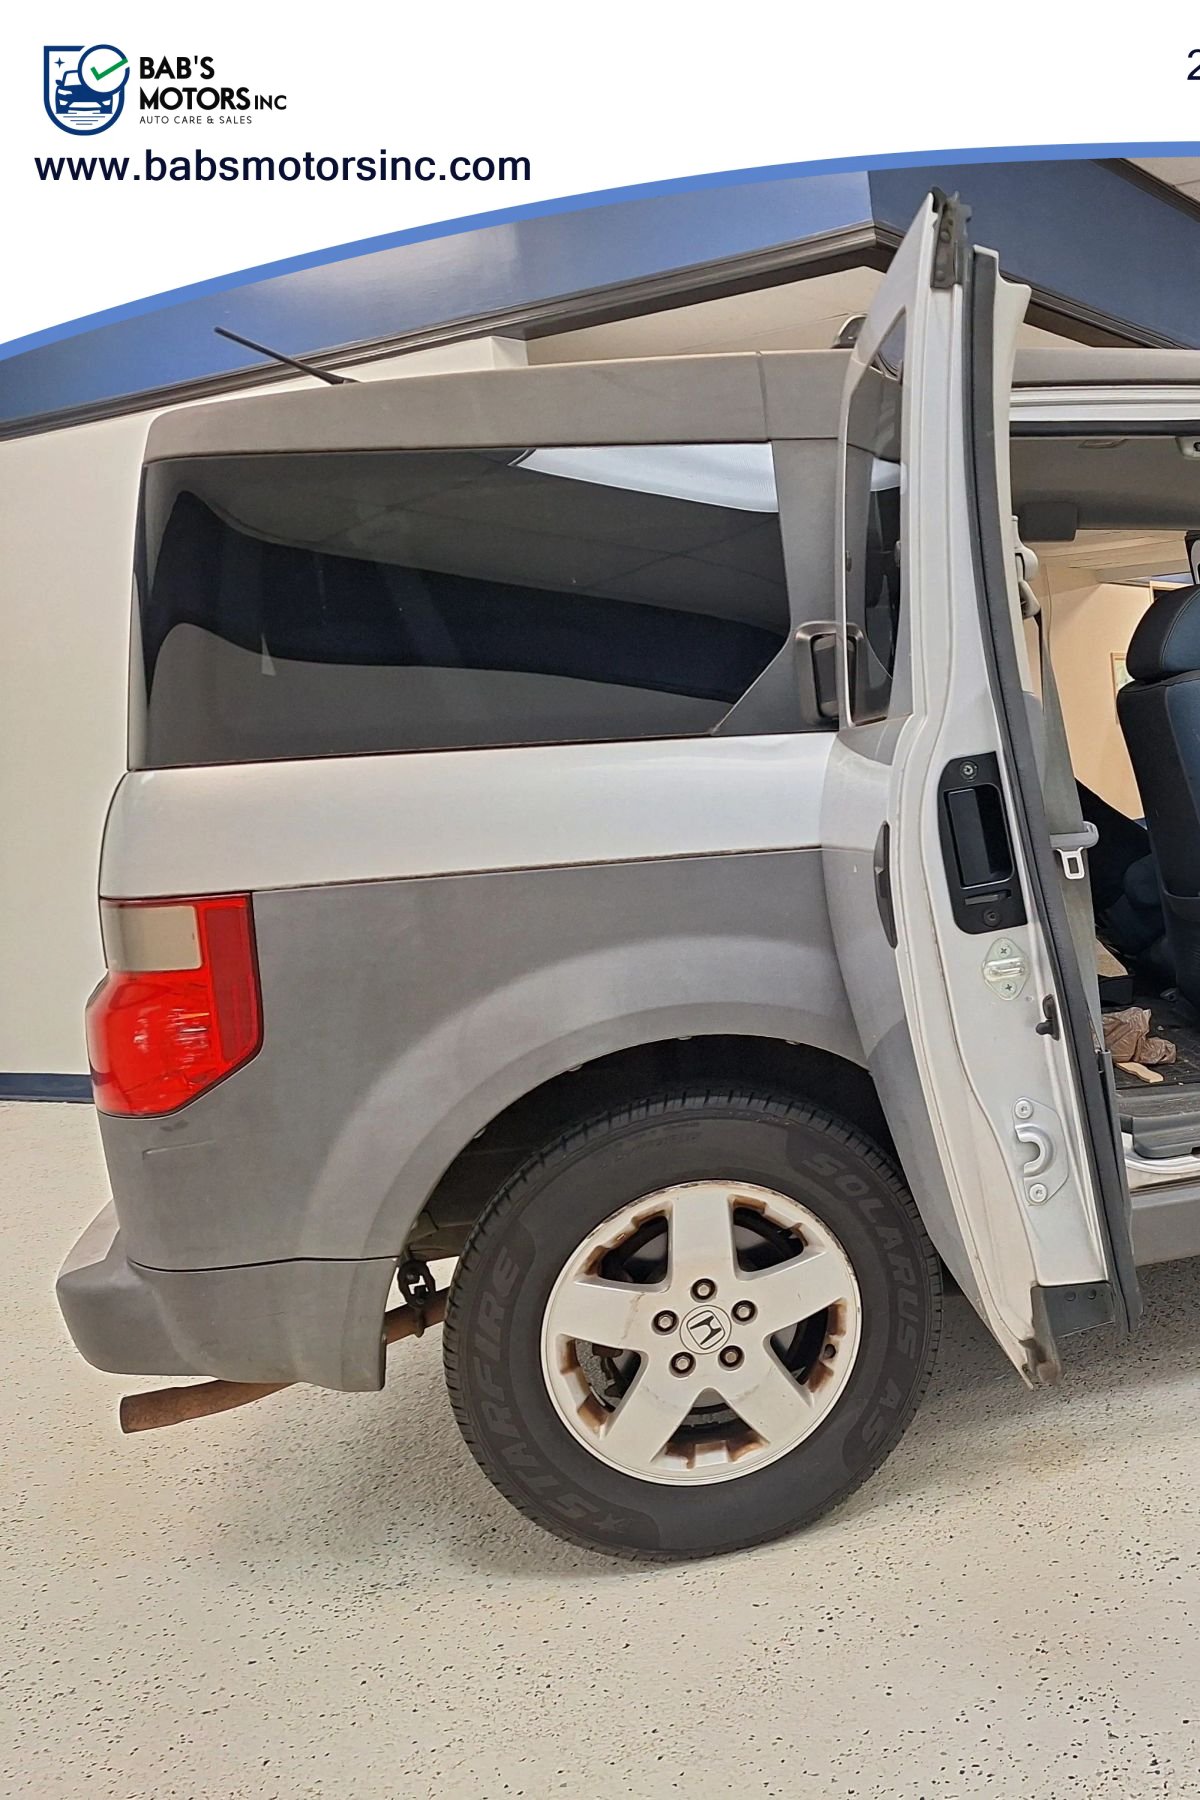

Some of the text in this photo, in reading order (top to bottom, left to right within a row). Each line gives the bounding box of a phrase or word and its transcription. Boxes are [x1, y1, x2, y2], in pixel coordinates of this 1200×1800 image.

[472, 1245, 601, 1520] STARFIRE
[801, 1152, 919, 1445] SOLARUS AS
